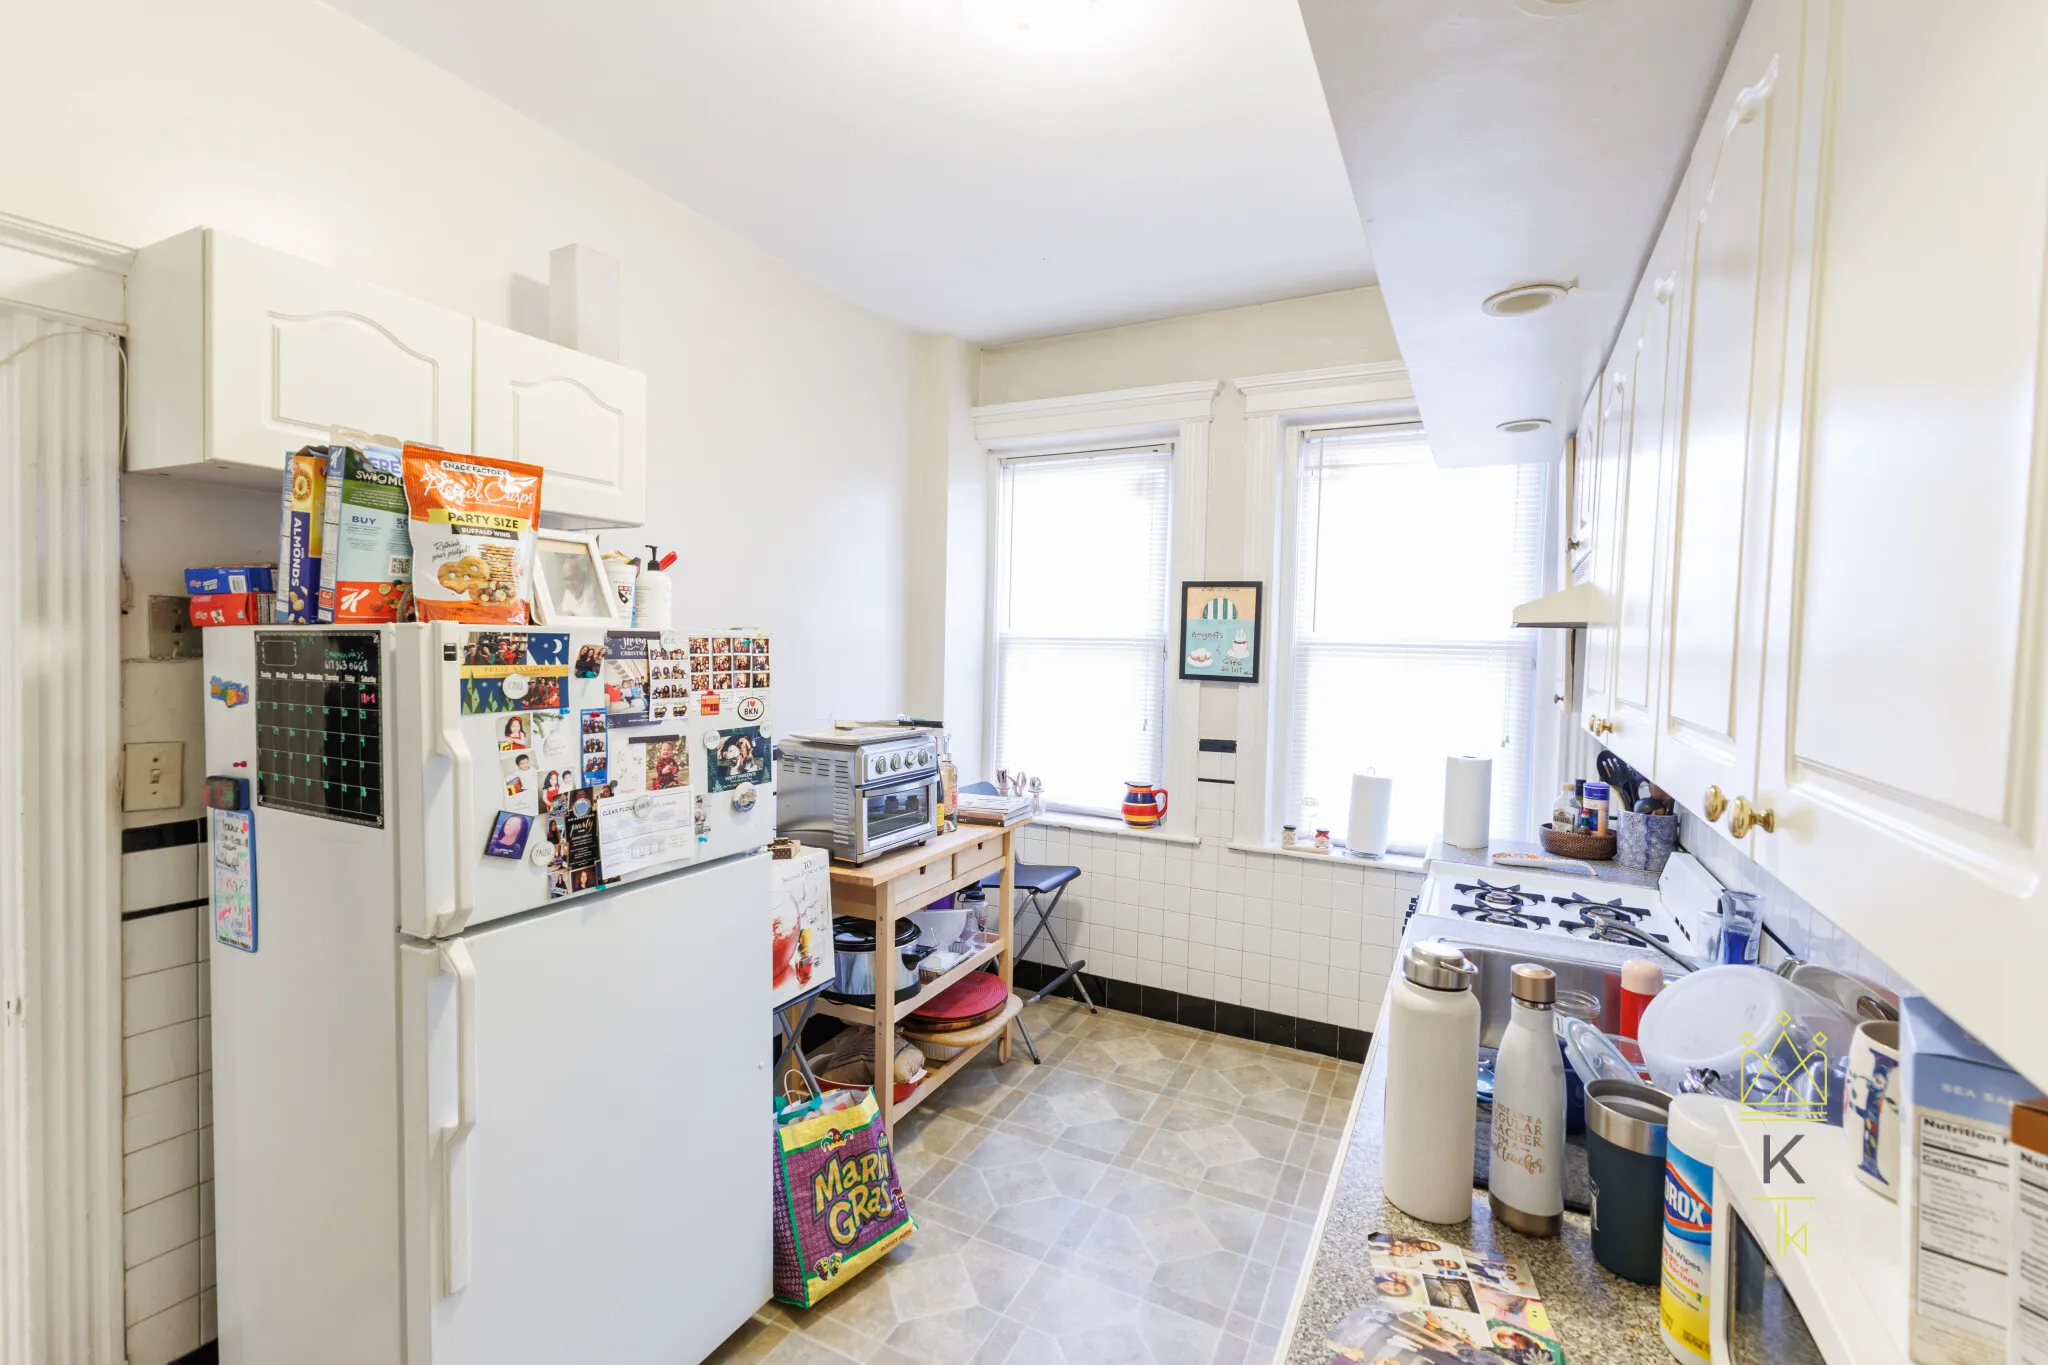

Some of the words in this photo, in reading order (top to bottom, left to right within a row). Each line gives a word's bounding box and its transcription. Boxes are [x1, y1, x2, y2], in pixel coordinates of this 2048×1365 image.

[443, 462, 470, 472] SNACK
[472, 466, 508, 477] FACTORY
[351, 515, 376, 525] BUY
[448, 512, 490, 525] PARTY
[494, 517, 519, 529] SIZE
[461, 527, 493, 536] BUFFALO
[493, 530, 511, 538] WING
[291, 517, 303, 587] ALMONDS
[744, 708, 759, 716] BKN
[602, 807, 619, 817] CLEAR
[619, 804, 634, 813] FLOU
[803, 859, 812, 870] 10
[1940, 1082, 1976, 1099] SEA
[1924, 1118, 1996, 1143] Nutrition
[1922, 1154, 1977, 1175] Calories
